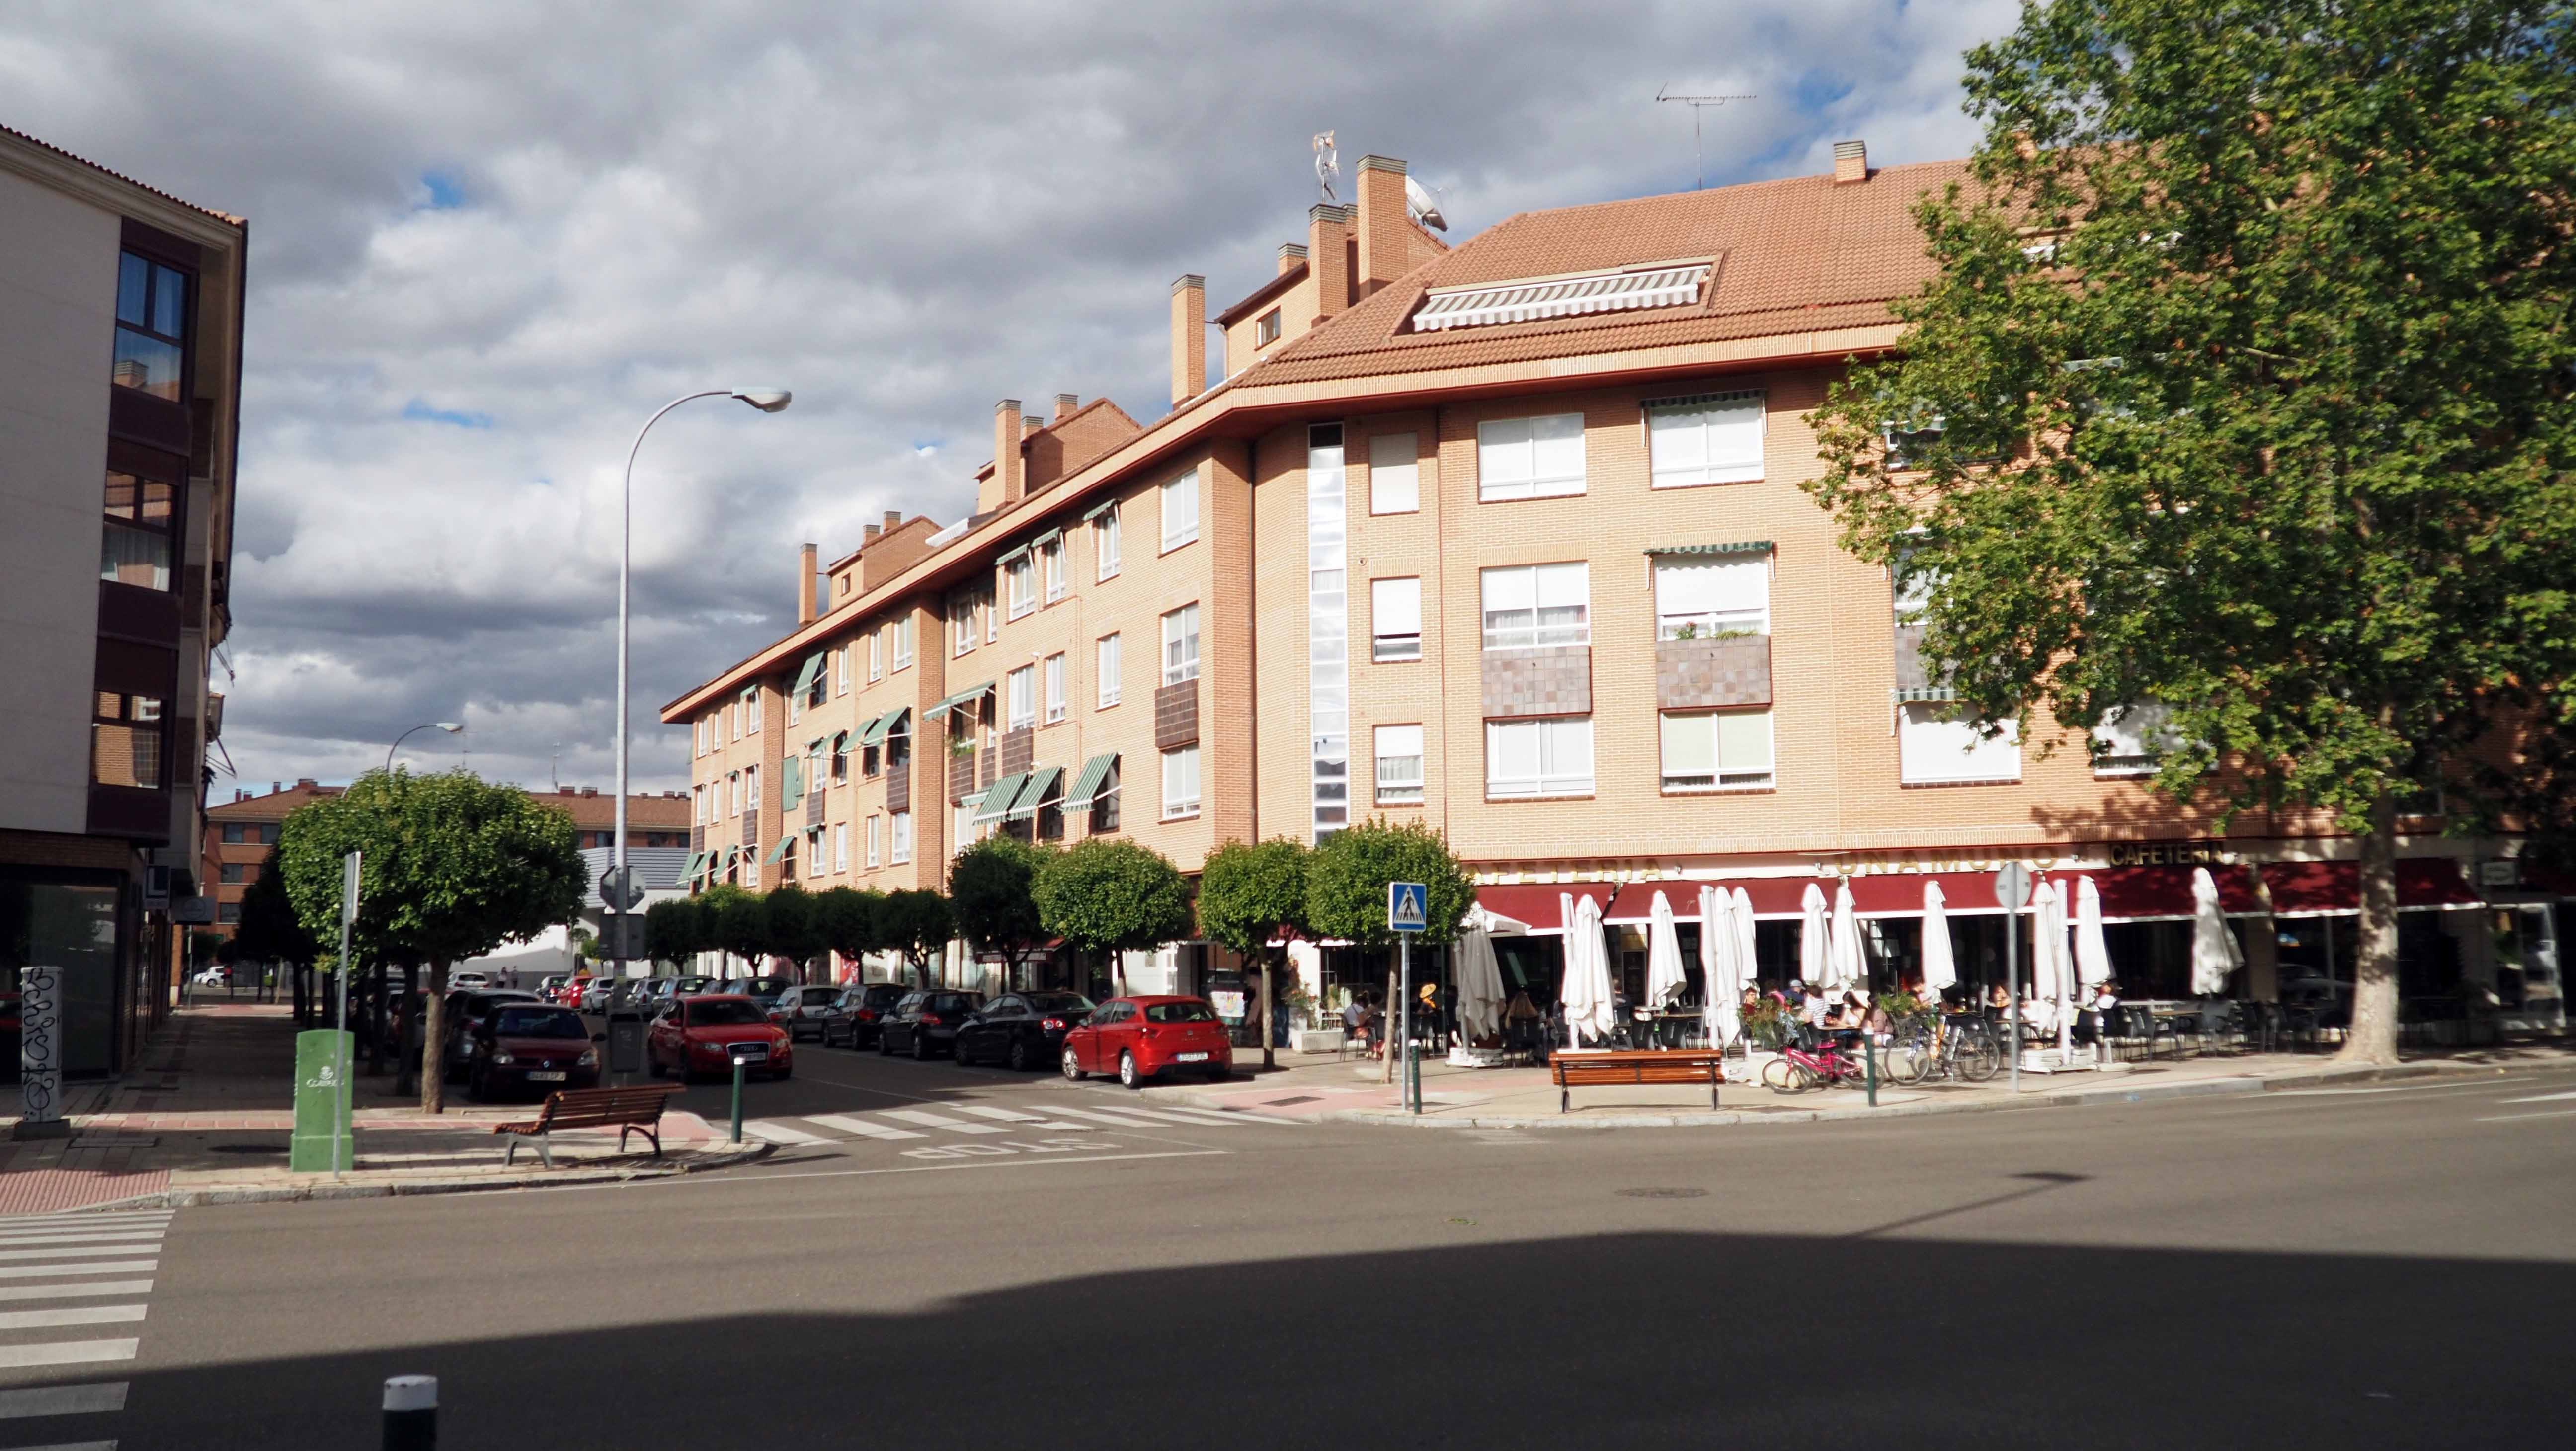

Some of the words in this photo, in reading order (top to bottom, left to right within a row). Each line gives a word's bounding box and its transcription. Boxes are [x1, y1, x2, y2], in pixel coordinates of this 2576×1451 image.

[1836, 846, 2060, 875] UNAMUNO
[2110, 842, 2223, 866] CAFETERIA
[1464, 857, 1664, 885] AFETERIA
[899, 1138, 1123, 1159] STOP
